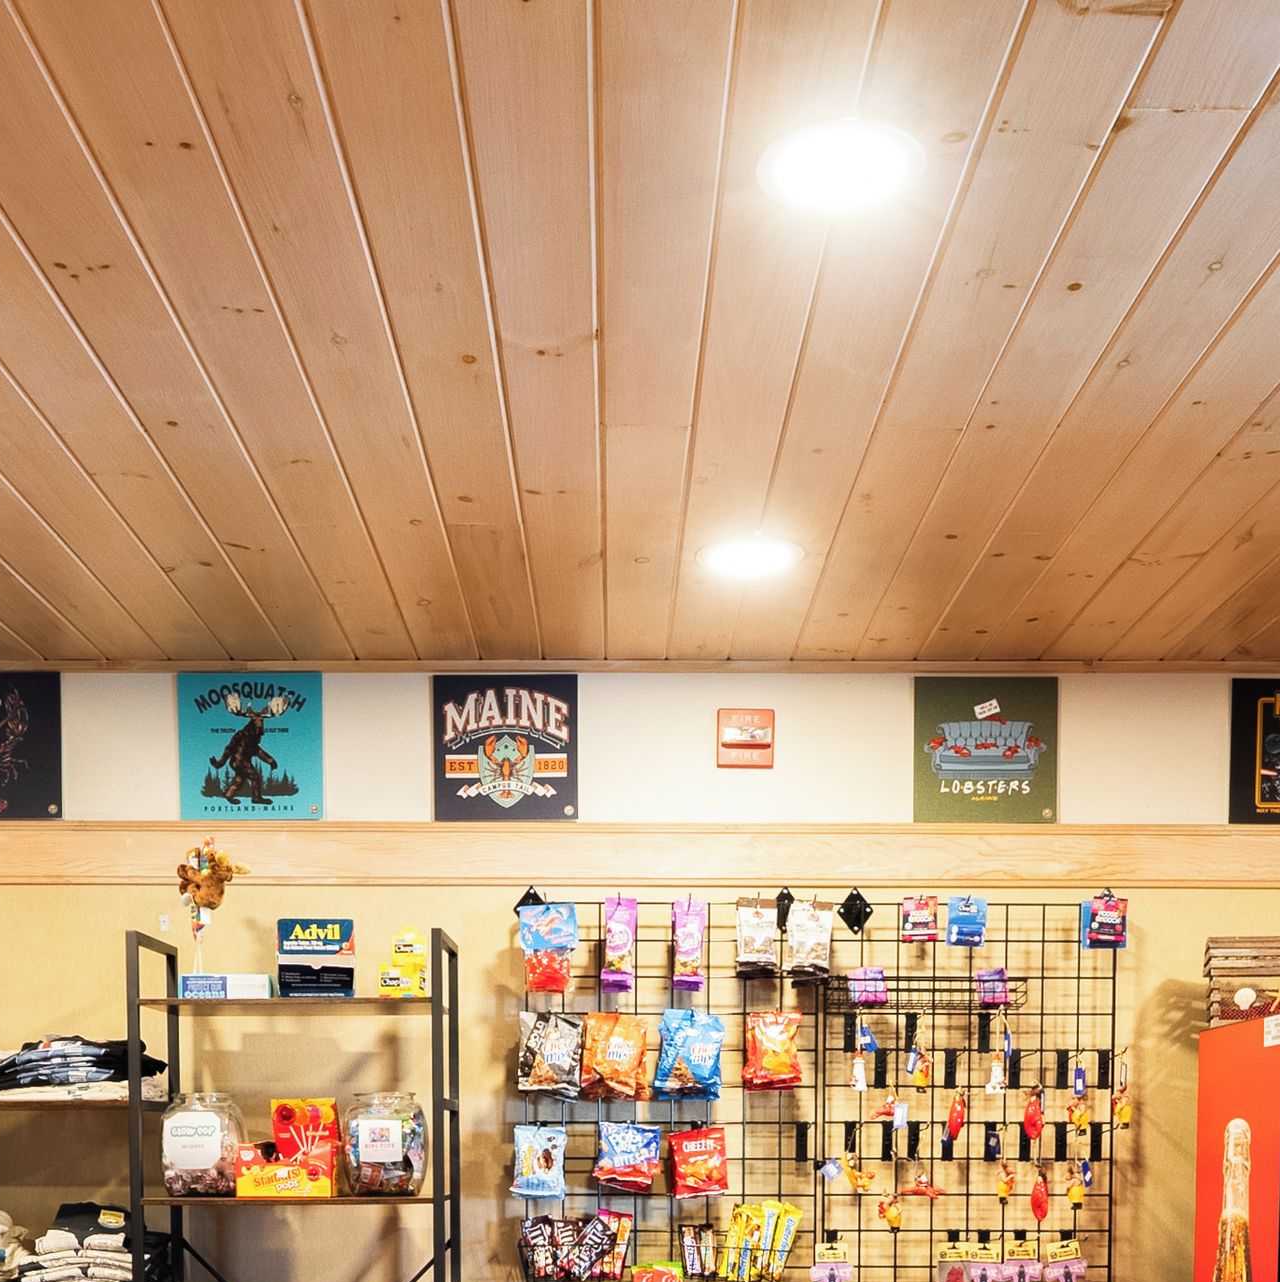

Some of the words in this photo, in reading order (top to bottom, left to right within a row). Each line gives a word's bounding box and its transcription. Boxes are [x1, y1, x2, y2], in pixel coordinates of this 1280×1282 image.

[444, 688, 570, 743] MAINE
[731, 714, 761, 724] FIRE
[730, 751, 761, 761] FIRE
[448, 760, 474, 773] EST
[538, 759, 564, 771] 1820
[289, 924, 341, 940] Advil
